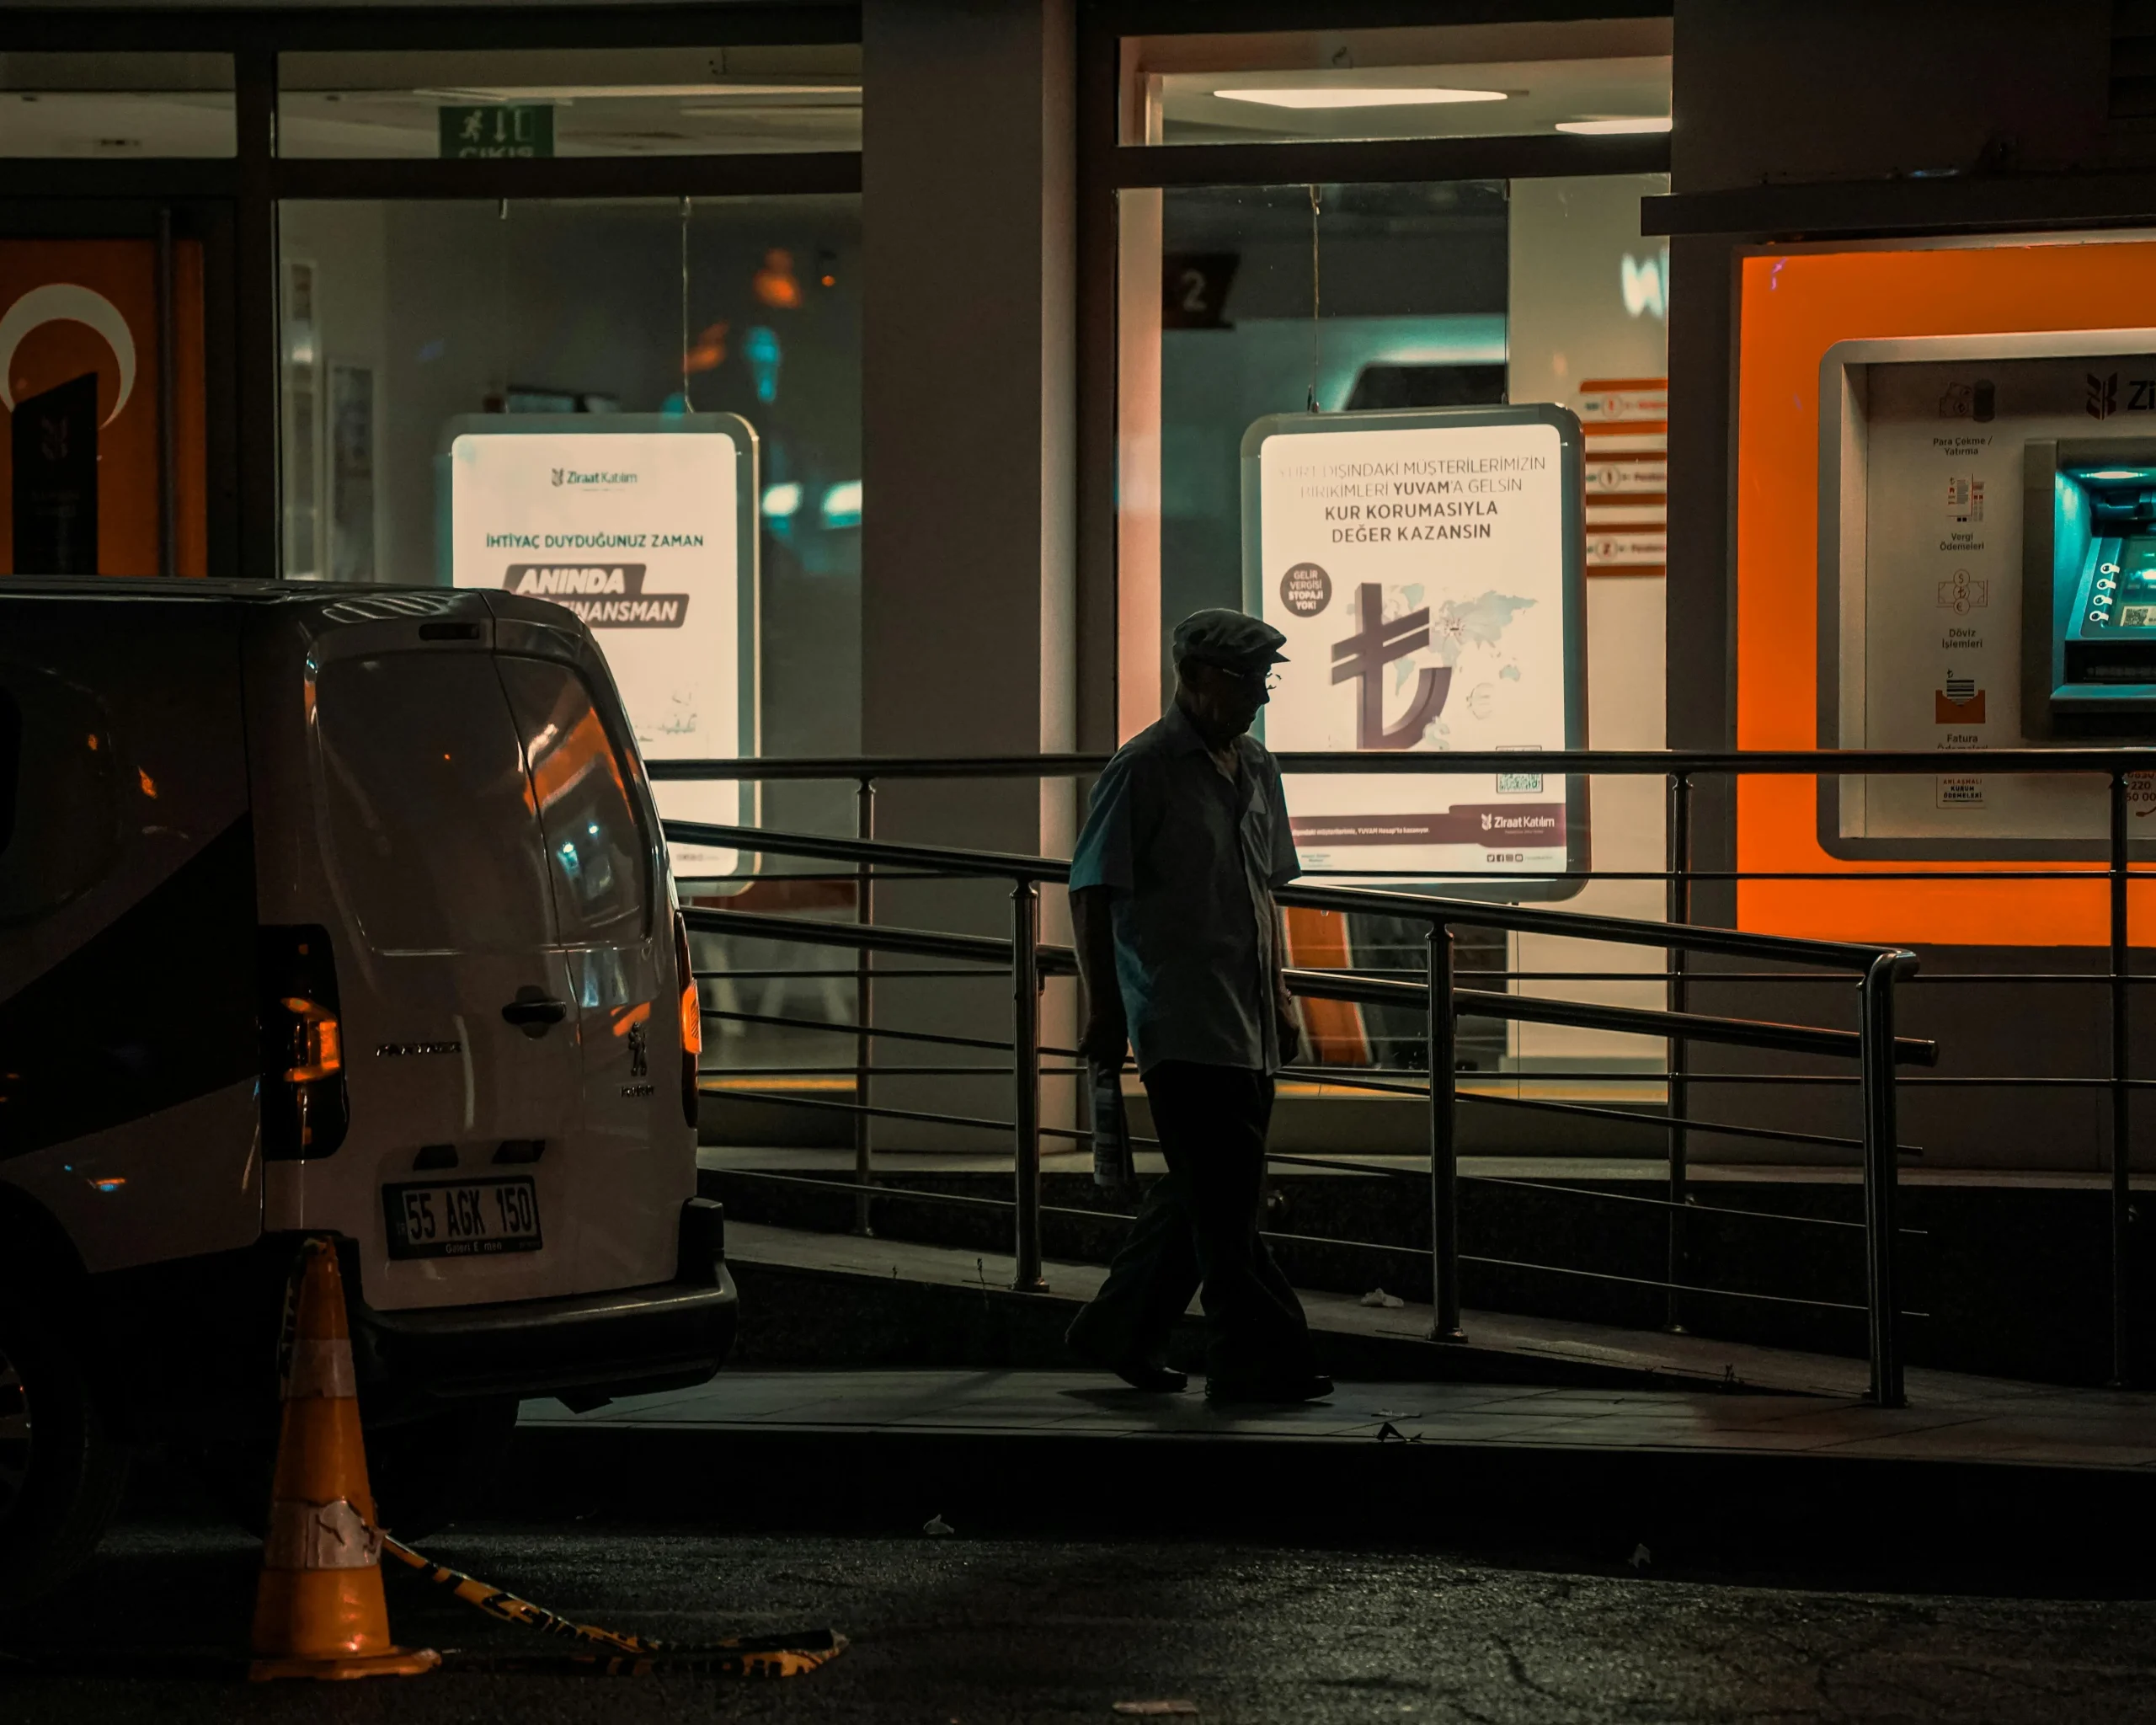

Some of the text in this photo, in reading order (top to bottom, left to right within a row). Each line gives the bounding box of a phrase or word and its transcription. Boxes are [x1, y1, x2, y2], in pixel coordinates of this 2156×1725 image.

[1181, 267, 1208, 312] 2
[1404, 455, 1545, 477] MÜŞTERİLERİMİZİN
[567, 471, 599, 484] Ziraat
[1394, 478, 1463, 496] YUVAM'A
[1469, 478, 1522, 494] GELSİN
[1326, 501, 1497, 521] KUR KORUMASIYLA
[486, 532, 703, 549] İHTİYAÇ DUYDUĞUNUZ ZAMAN
[1332, 523, 1492, 543] DEĞER KAZANSIN
[515, 568, 627, 595] ANINDA
[1949, 628, 1976, 638] Döviz
[1947, 734, 1978, 743] Fatura
[2131, 781, 2151, 790] 220
[1494, 814, 1555, 829] Ziraat Katılım
[406, 1193, 435, 1239] 55
[446, 1188, 485, 1236] AGK
[496, 1187, 531, 1232] 150
